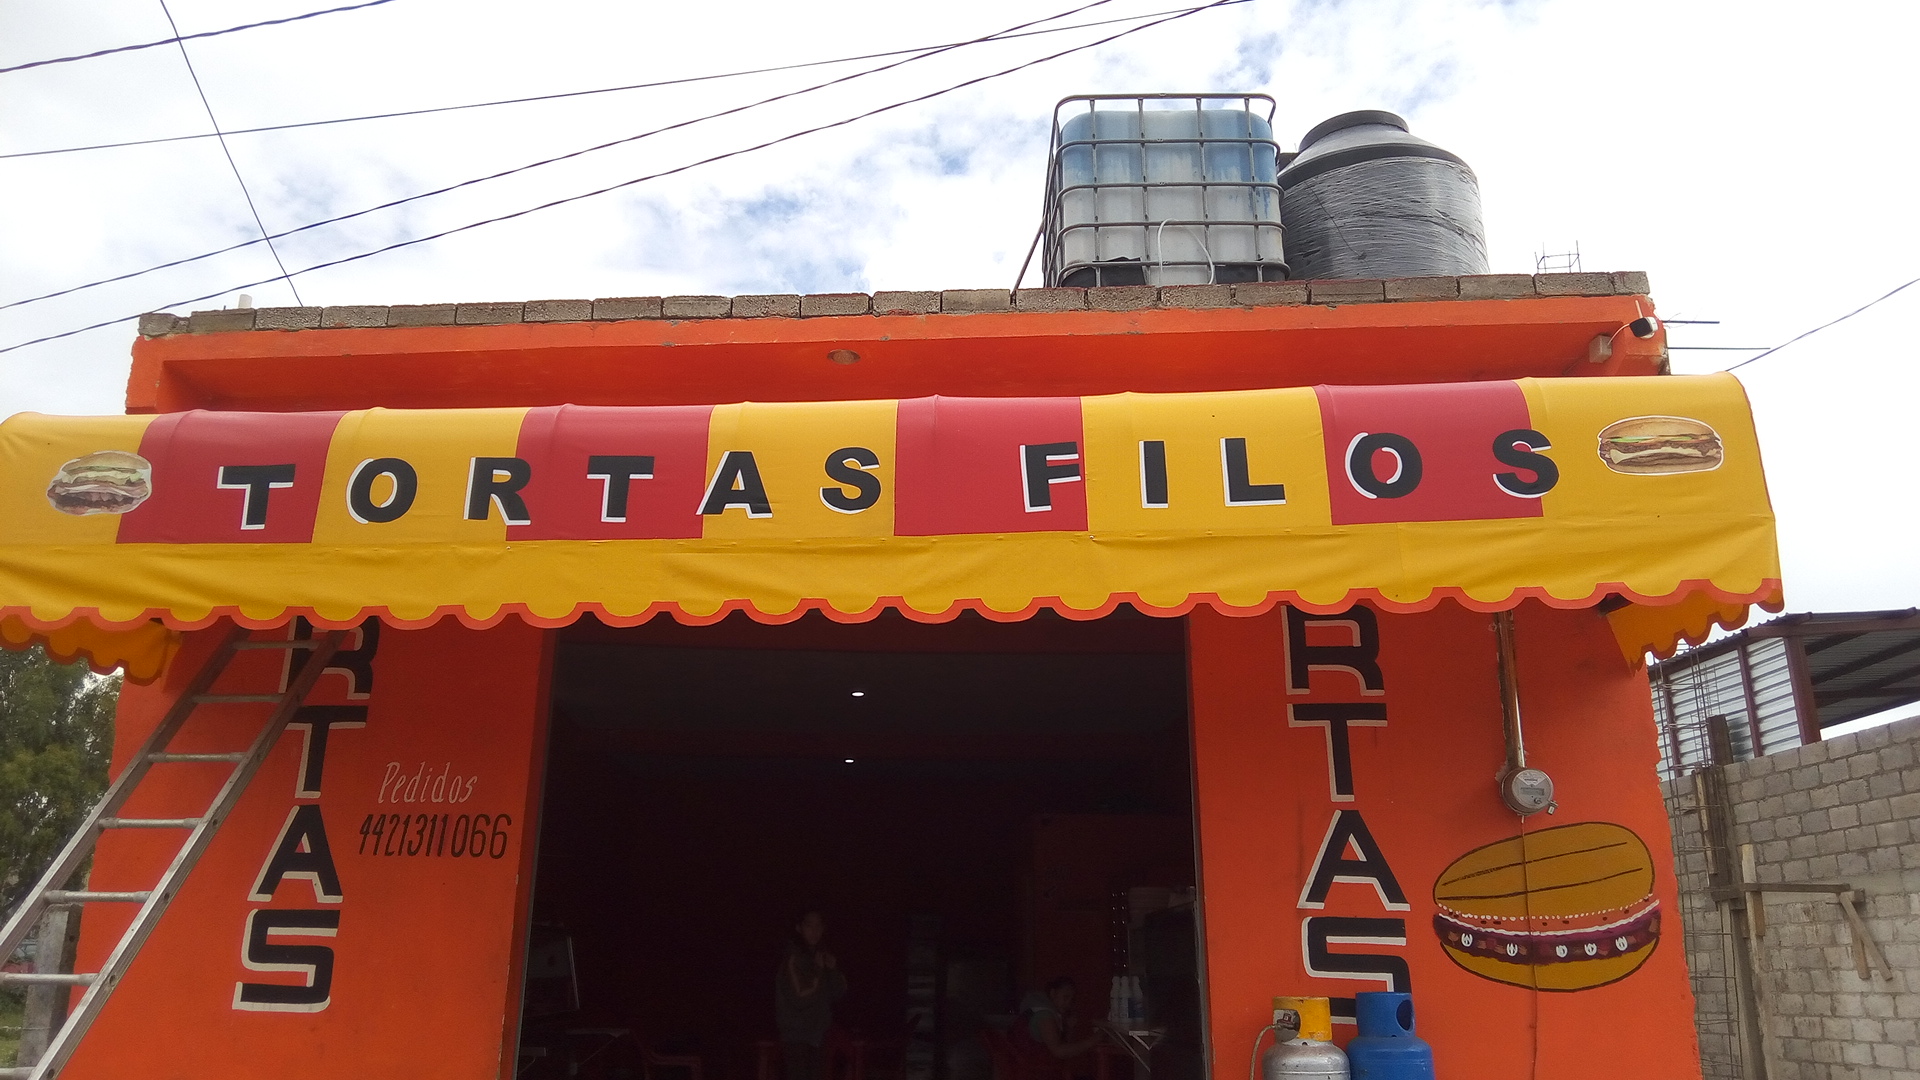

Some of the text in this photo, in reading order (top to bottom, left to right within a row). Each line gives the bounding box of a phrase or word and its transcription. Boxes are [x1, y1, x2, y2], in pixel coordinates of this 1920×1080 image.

[216, 428, 1559, 530] TORTAS FILOS
[377, 761, 478, 804] Pedidos
[358, 813, 513, 859] 4421311066
